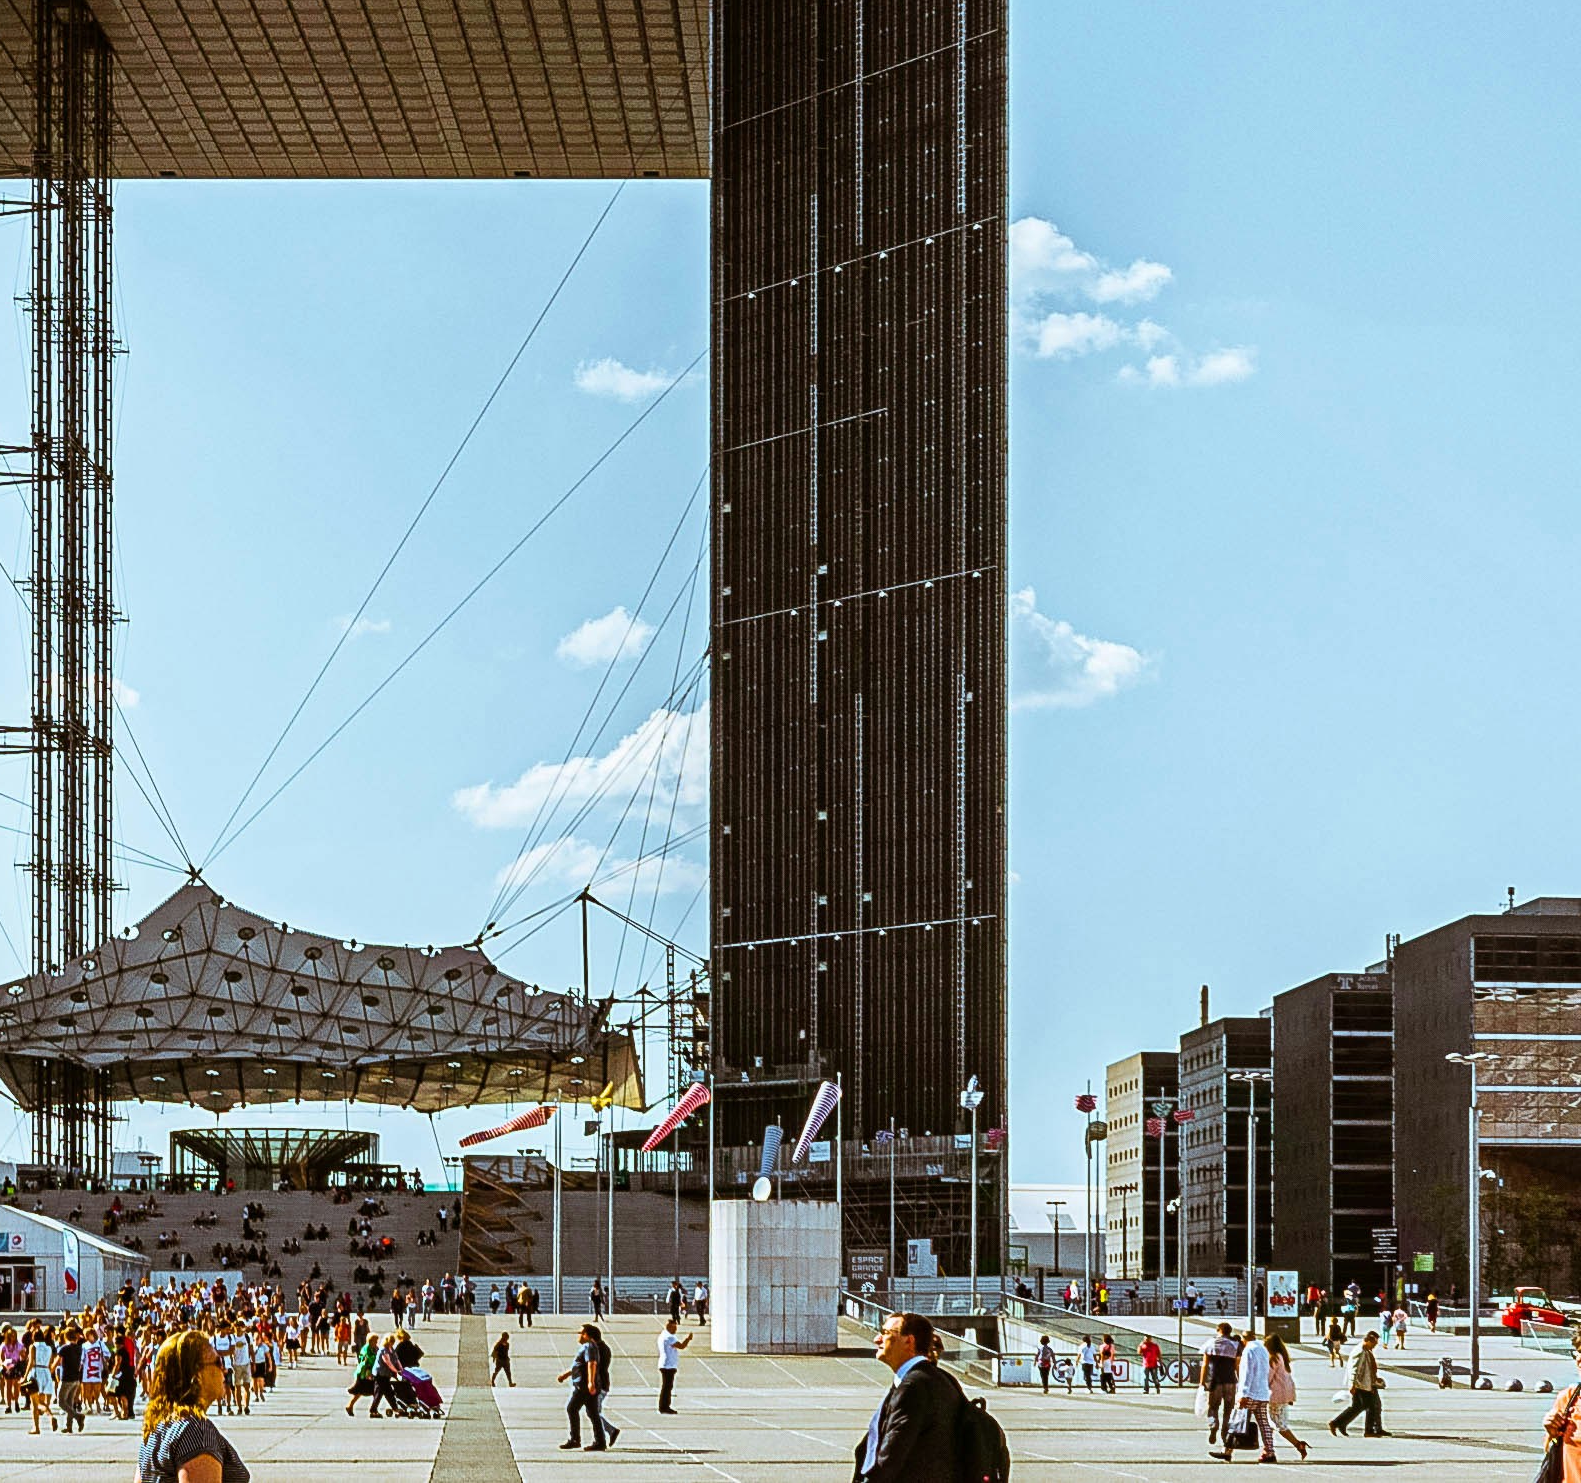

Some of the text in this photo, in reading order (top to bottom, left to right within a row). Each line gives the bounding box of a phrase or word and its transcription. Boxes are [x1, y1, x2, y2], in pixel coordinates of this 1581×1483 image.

[851, 1256, 884, 1264] ESPACE
[851, 1264, 884, 1272] GRANDE
[851, 1272, 879, 1281] ARCHE
